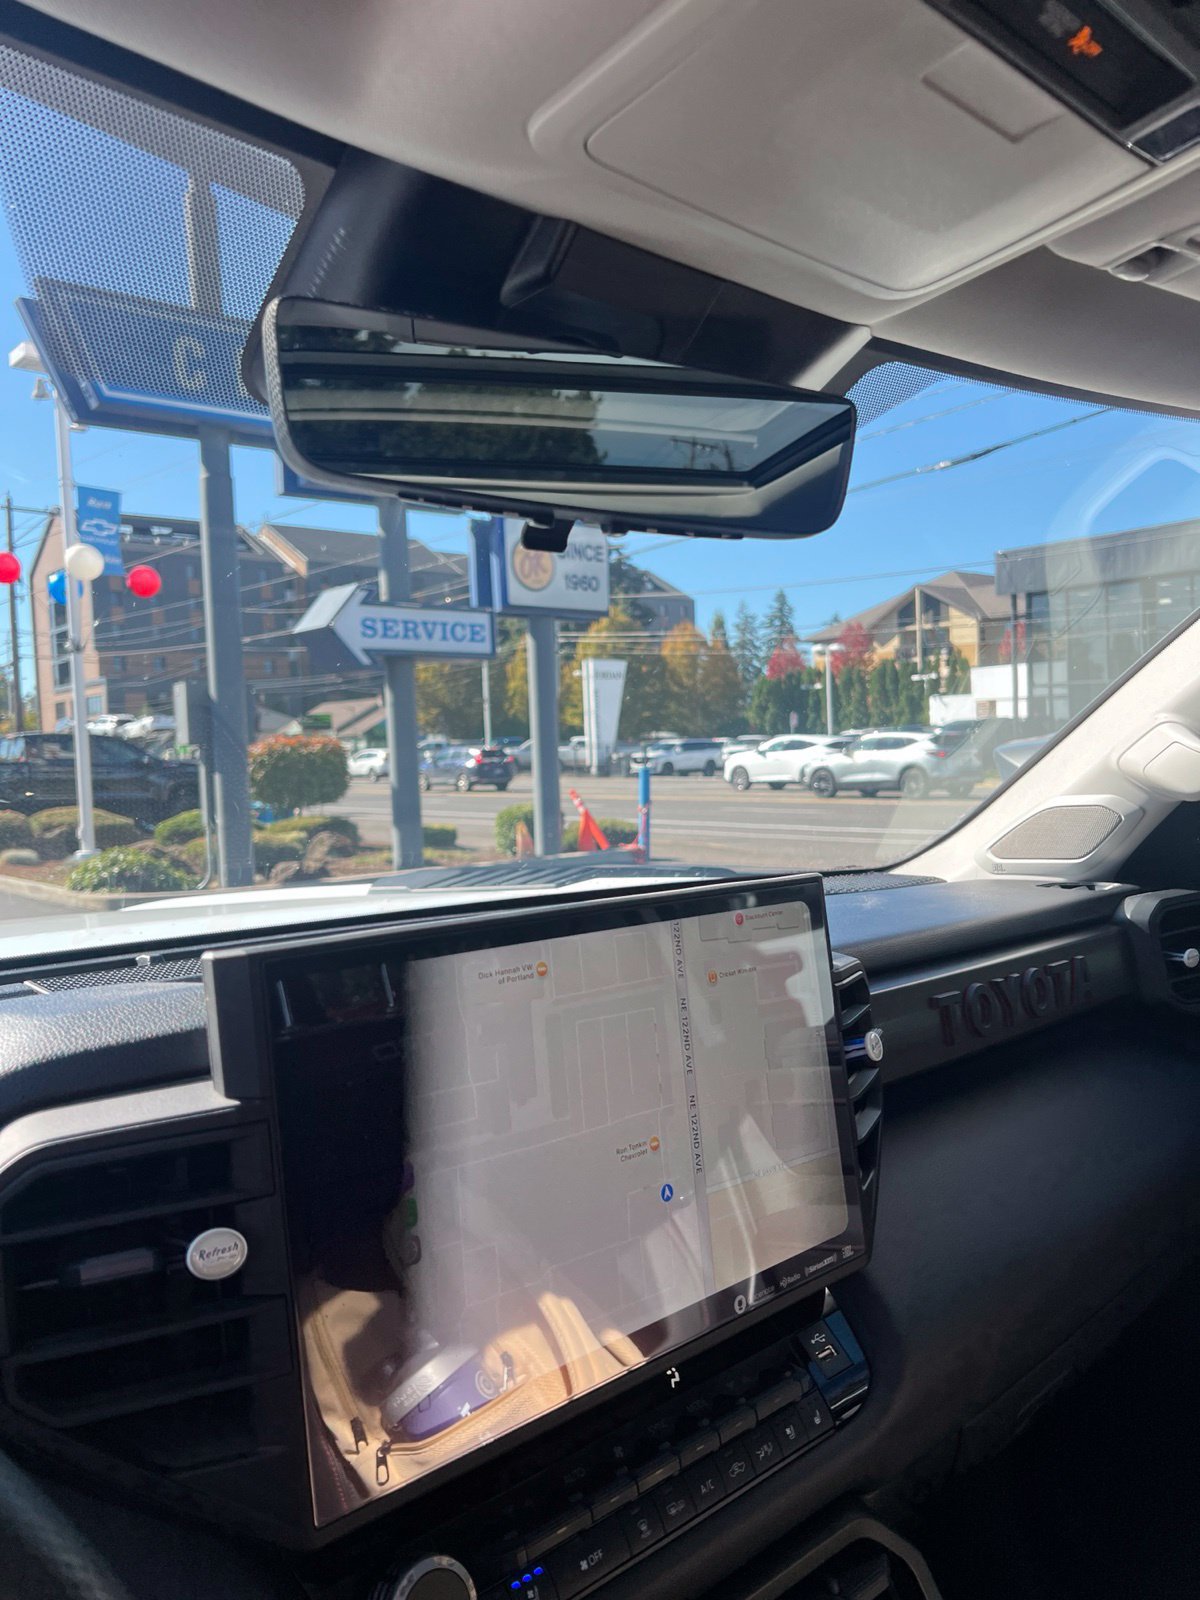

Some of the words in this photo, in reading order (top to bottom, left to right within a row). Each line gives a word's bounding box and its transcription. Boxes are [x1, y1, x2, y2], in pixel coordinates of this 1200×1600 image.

[564, 573, 599, 592] 1960
[361, 617, 486, 643] SERVICE
[672, 921, 682, 956] 122ND
[478, 970, 493, 980] Dick
[494, 966, 521, 976] Hannah
[521, 963, 533, 972] VW
[498, 977, 505, 985] of
[506, 972, 534, 983] Portland
[676, 959, 684, 979] AVE
[680, 997, 688, 1012] NE
[928, 955, 1092, 1047] TOYOTA
[681, 1016, 691, 1051] 122ND
[685, 1054, 694, 1076] AVE
[688, 1094, 697, 1110] NE
[690, 1113, 700, 1150] 122ND
[615, 1146, 627, 1155] Ron
[694, 1152, 703, 1175] AVE
[198, 1241, 239, 1261] Refresh
[700, 1479, 715, 1496] A/C
[588, 1548, 604, 1566] OFF
